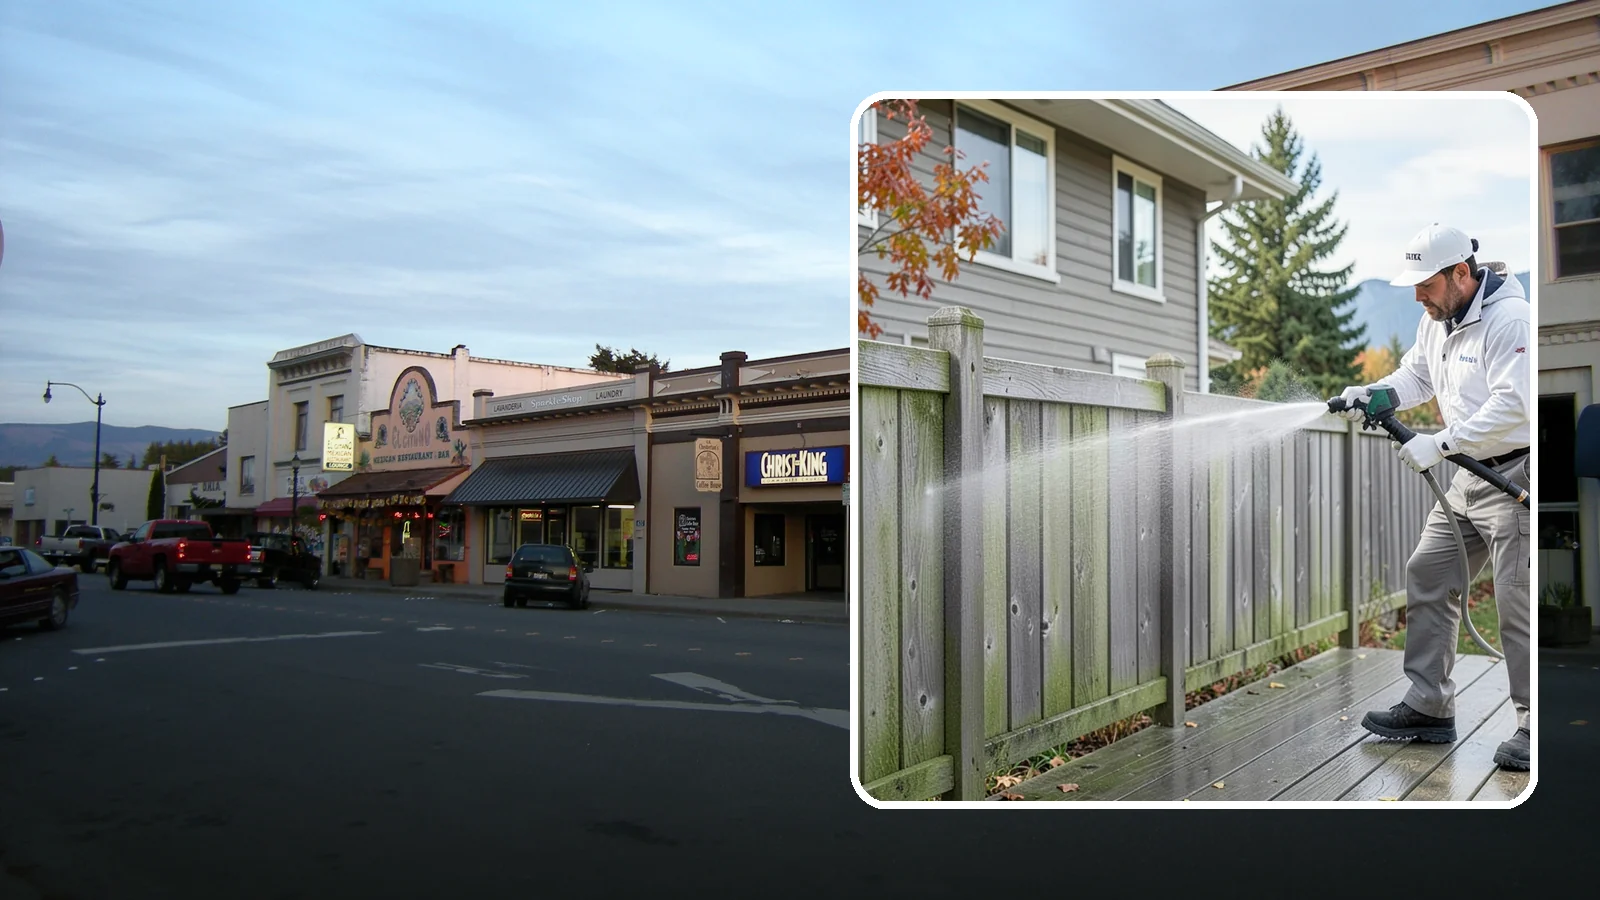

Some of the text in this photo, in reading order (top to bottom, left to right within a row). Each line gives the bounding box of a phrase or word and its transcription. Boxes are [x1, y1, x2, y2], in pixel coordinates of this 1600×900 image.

[493, 402, 522, 412] LAVANDERIA
[561, 395, 582, 407] Shop
[595, 389, 623, 400] LAUNDRY
[373, 450, 450, 464] MEXICAN RESTAURANT BAR
